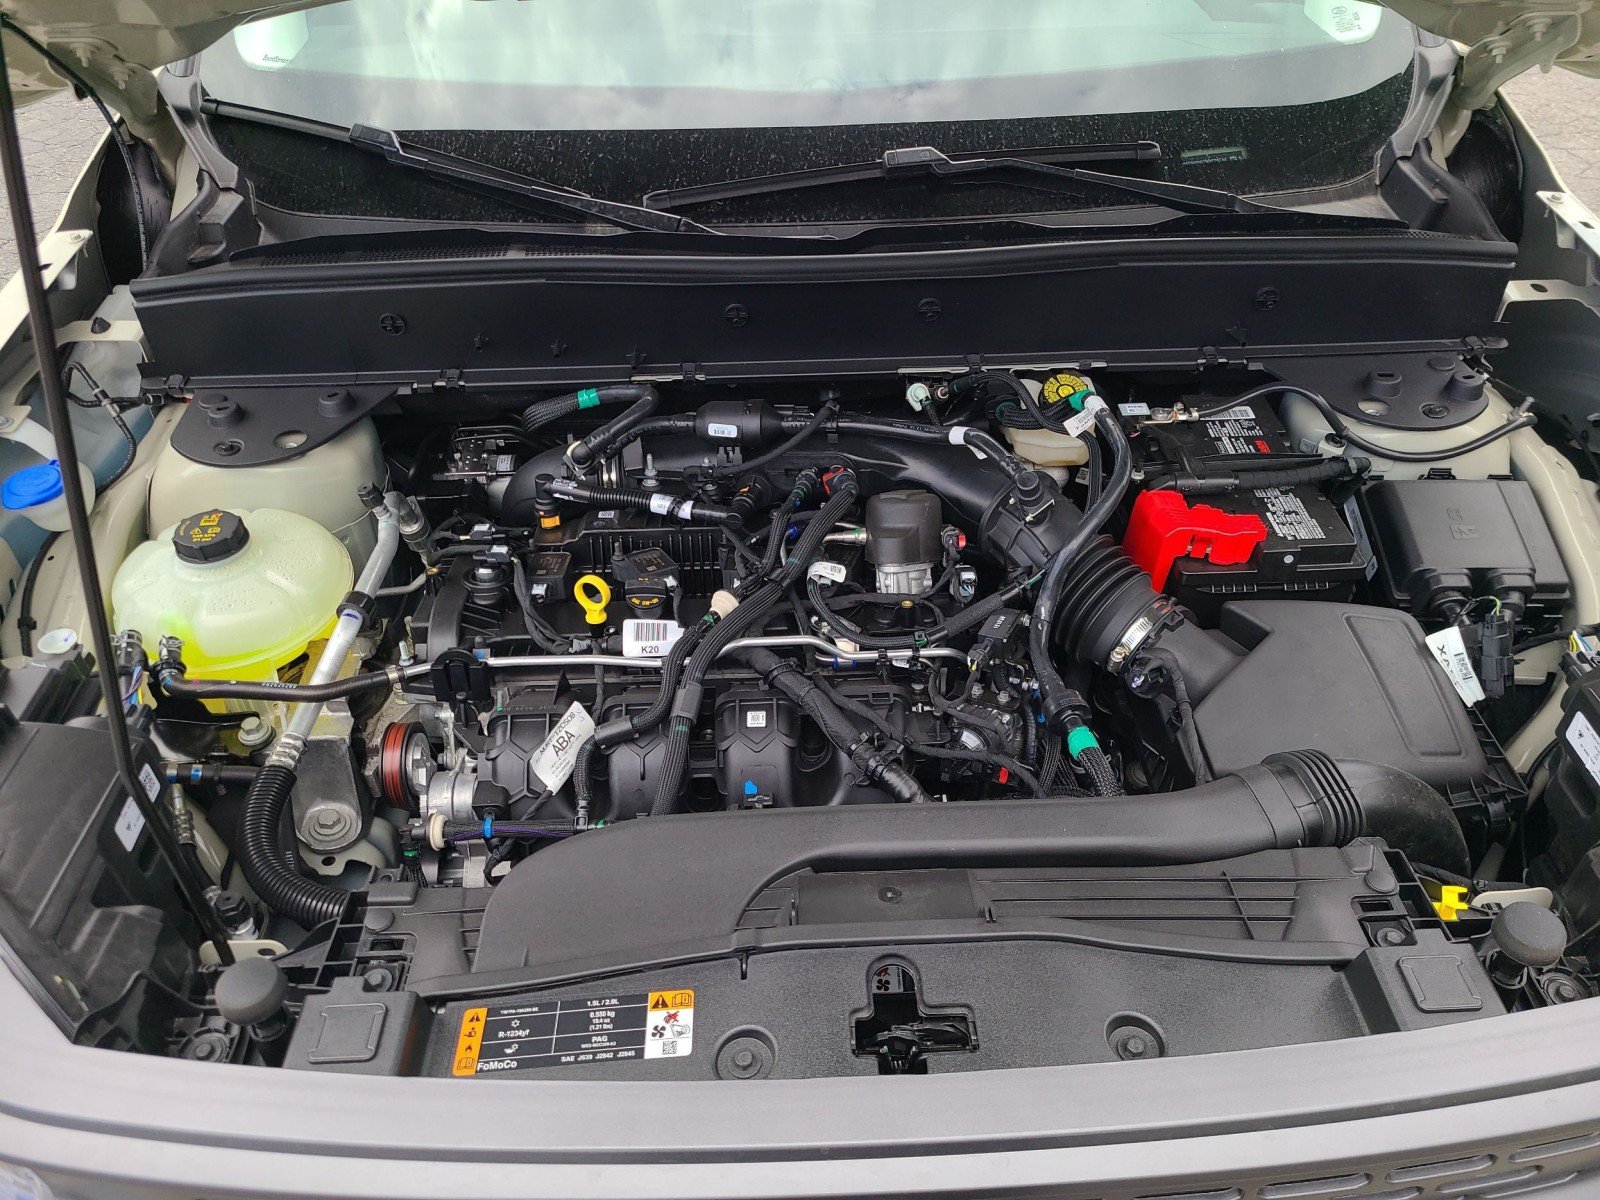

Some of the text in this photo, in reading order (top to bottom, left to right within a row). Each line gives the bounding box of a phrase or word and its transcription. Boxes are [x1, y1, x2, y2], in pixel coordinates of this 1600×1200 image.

[641, 645, 660, 654] K20
[551, 730, 576, 757] ABA
[498, 1028, 530, 1039] R-1234yf
[591, 1035, 608, 1043] PAG
[477, 1059, 518, 1071] FoMoCo
